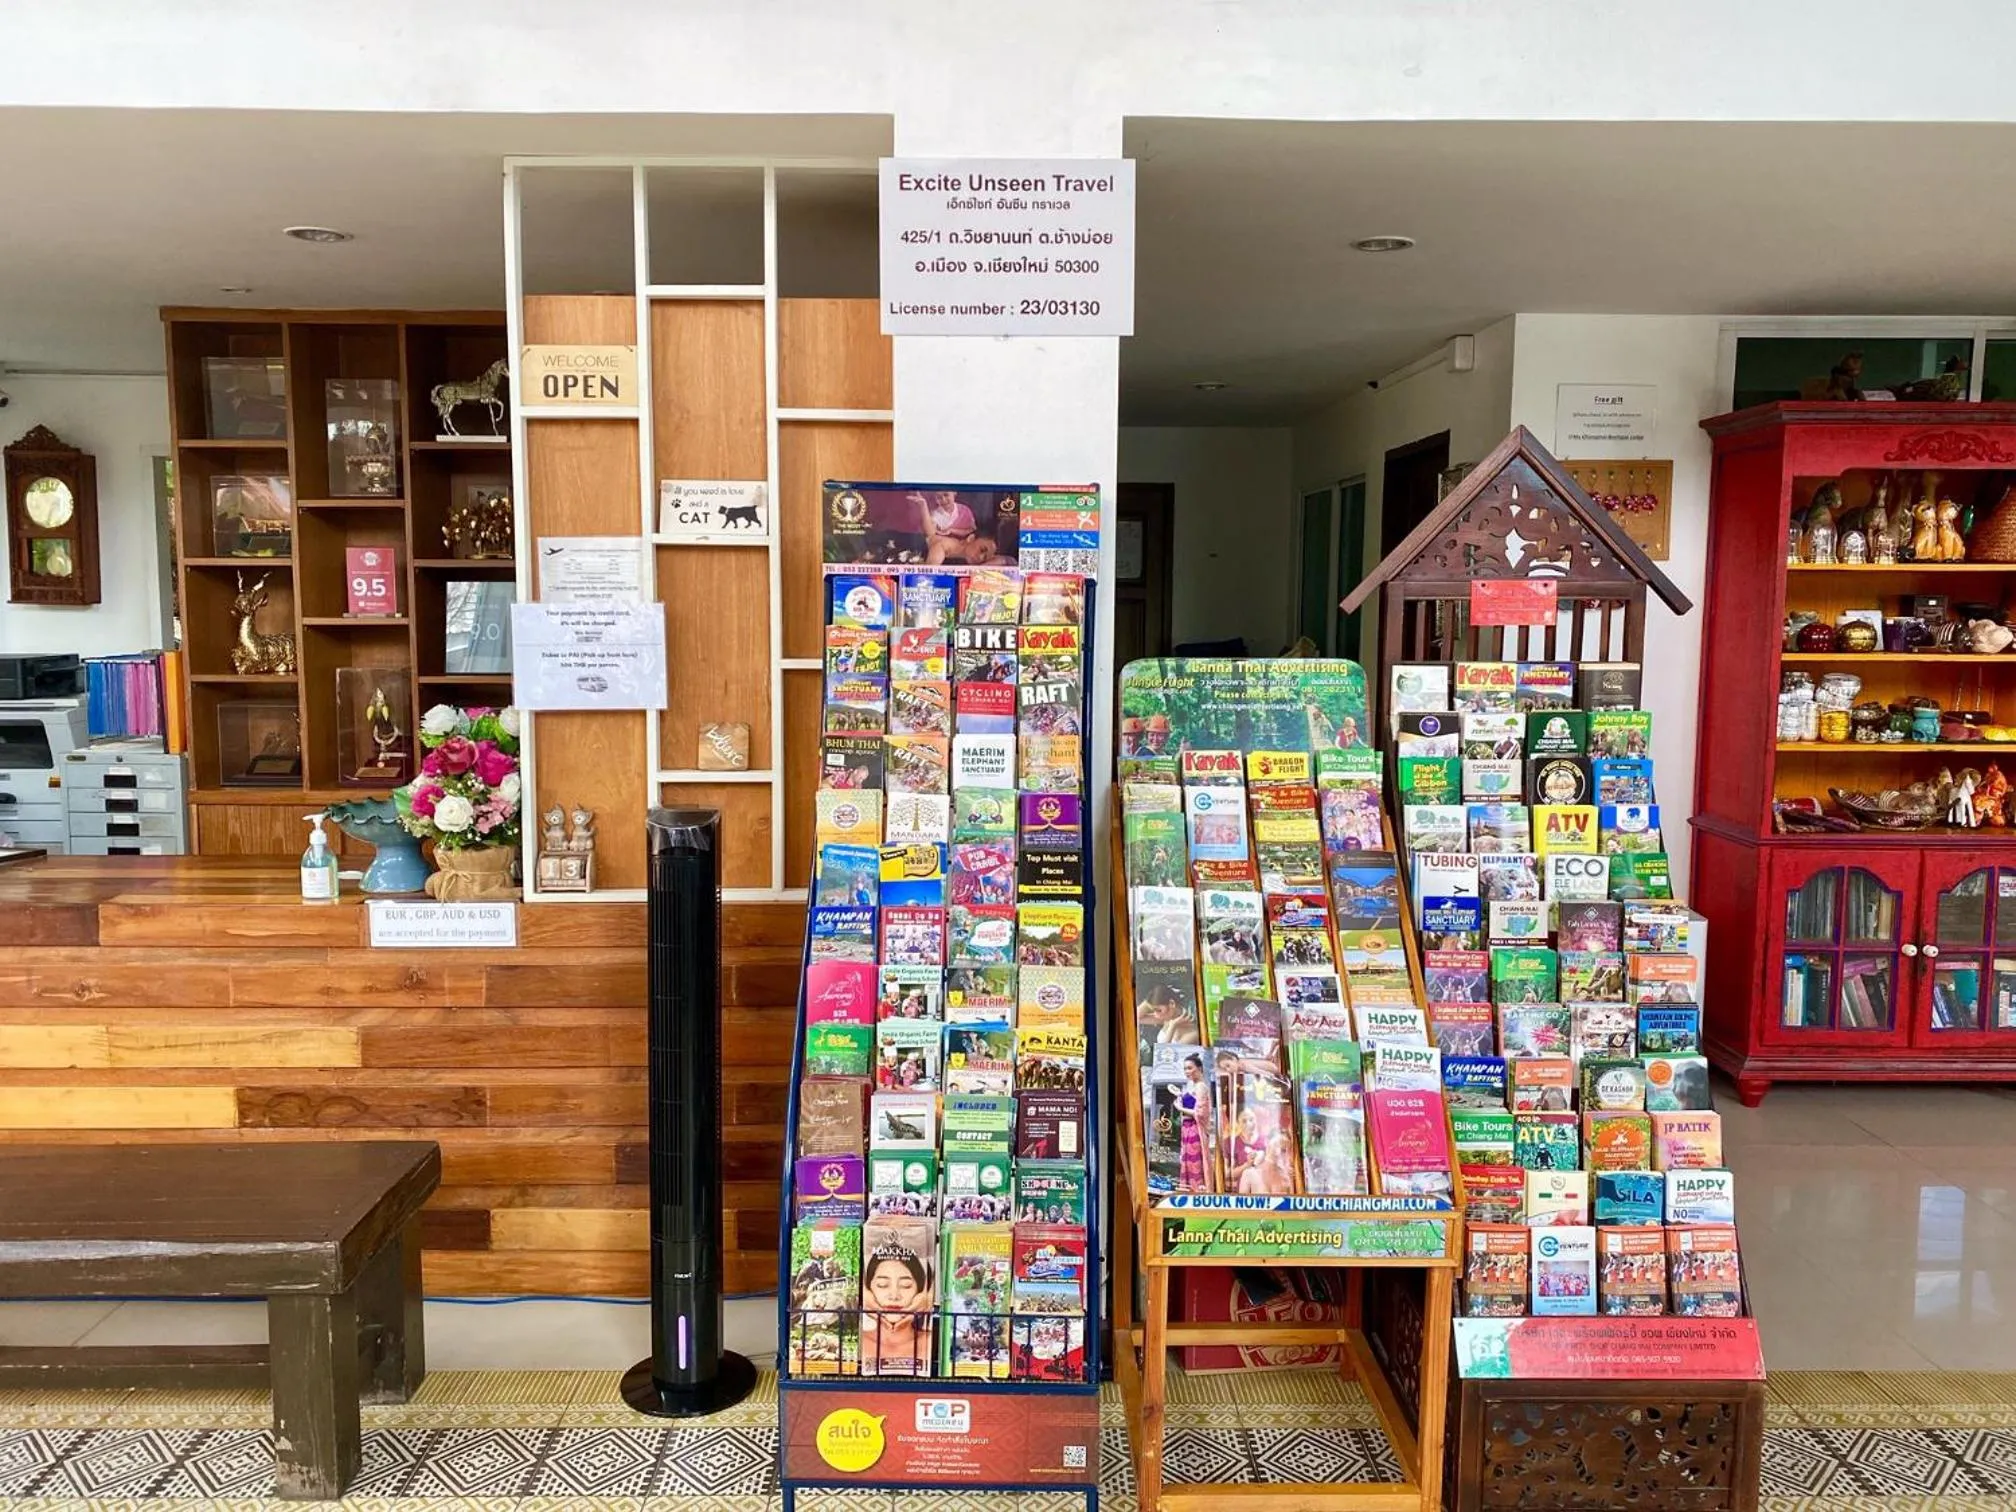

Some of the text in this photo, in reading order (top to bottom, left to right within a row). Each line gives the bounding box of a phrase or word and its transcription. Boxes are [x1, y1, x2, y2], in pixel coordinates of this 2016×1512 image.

[899, 174, 1114, 192] Excite Unseen Travel
[996, 198, 1071, 211] อันซีน ทราเวล
[901, 228, 1113, 244] 425/1 ถ.วิชยานนท์ ต.ช้างม่อย
[915, 256, 1099, 273] อ.เมือง จ.เชียงใหม่ 50300
[890, 299, 1100, 316] License number 23/03130
[542, 354, 619, 368] WELCOME
[542, 374, 620, 398] OPEN
[679, 512, 710, 524] CAT
[352, 577, 386, 596] 9.5
[902, 592, 952, 603] SANCTUARY
[958, 628, 1017, 649] BIKE
[1019, 628, 1076, 650] Kayak
[1191, 661, 1348, 677] Lanna Thai Advertising
[1458, 664, 1515, 685] Kayak
[960, 688, 1012, 697] CYCLING
[1020, 683, 1070, 707] RAFT
[896, 690, 929, 710] RAFT
[1594, 714, 1648, 724] Johnny Boy
[826, 739, 880, 750] BHUM THAI
[894, 748, 926, 767] RAFT
[962, 748, 1005, 756] MAERIM
[1184, 752, 1240, 772] Kayak
[1414, 764, 1441, 774] Flight
[1546, 812, 1590, 833] ATV
[1026, 854, 1079, 863] Top Must visit
[1422, 855, 1478, 869] TUBING
[1482, 856, 1524, 864] ELEPHANT
[1554, 858, 1604, 877] ECO
[1554, 879, 1570, 888] ELE
[385, 910, 407, 920] EUR
[442, 910, 465, 920] AUD
[468, 911, 476, 919] &
[479, 910, 501, 920] USD
[816, 912, 872, 923] KHAMPAN
[1425, 915, 1476, 925] SANCTUARY
[836, 922, 871, 931] RAFTING
[395, 927, 434, 940] accepted
[436, 927, 450, 937] for
[451, 927, 466, 938] the
[968, 997, 1008, 1007] MAERIM
[1368, 1012, 1418, 1025] HAPPY
[1046, 1036, 1084, 1048] KANTA
[1382, 1049, 1434, 1064] HAPPY
[1446, 1063, 1504, 1074] KHAMPAN
[1466, 1074, 1502, 1082] RAFTING
[1454, 1122, 1513, 1132] Bike Tours
[1664, 1122, 1712, 1134] JP BATIK
[956, 1132, 993, 1140] CONTACT
[1466, 1132, 1494, 1140] Chiang
[1518, 1126, 1556, 1144] ATV
[1676, 1180, 1726, 1191] HAPPY
[1192, 1196, 1271, 1210] BOOK NOW!
[1290, 1198, 1437, 1211] TOUCHCHIANGMAI.COM
[1672, 1208, 1688, 1220] NO
[1168, 1228, 1344, 1248] Lanna Thai Advertising
[920, 1402, 966, 1417] TOP
[828, 1419, 871, 1438] สนใจ
